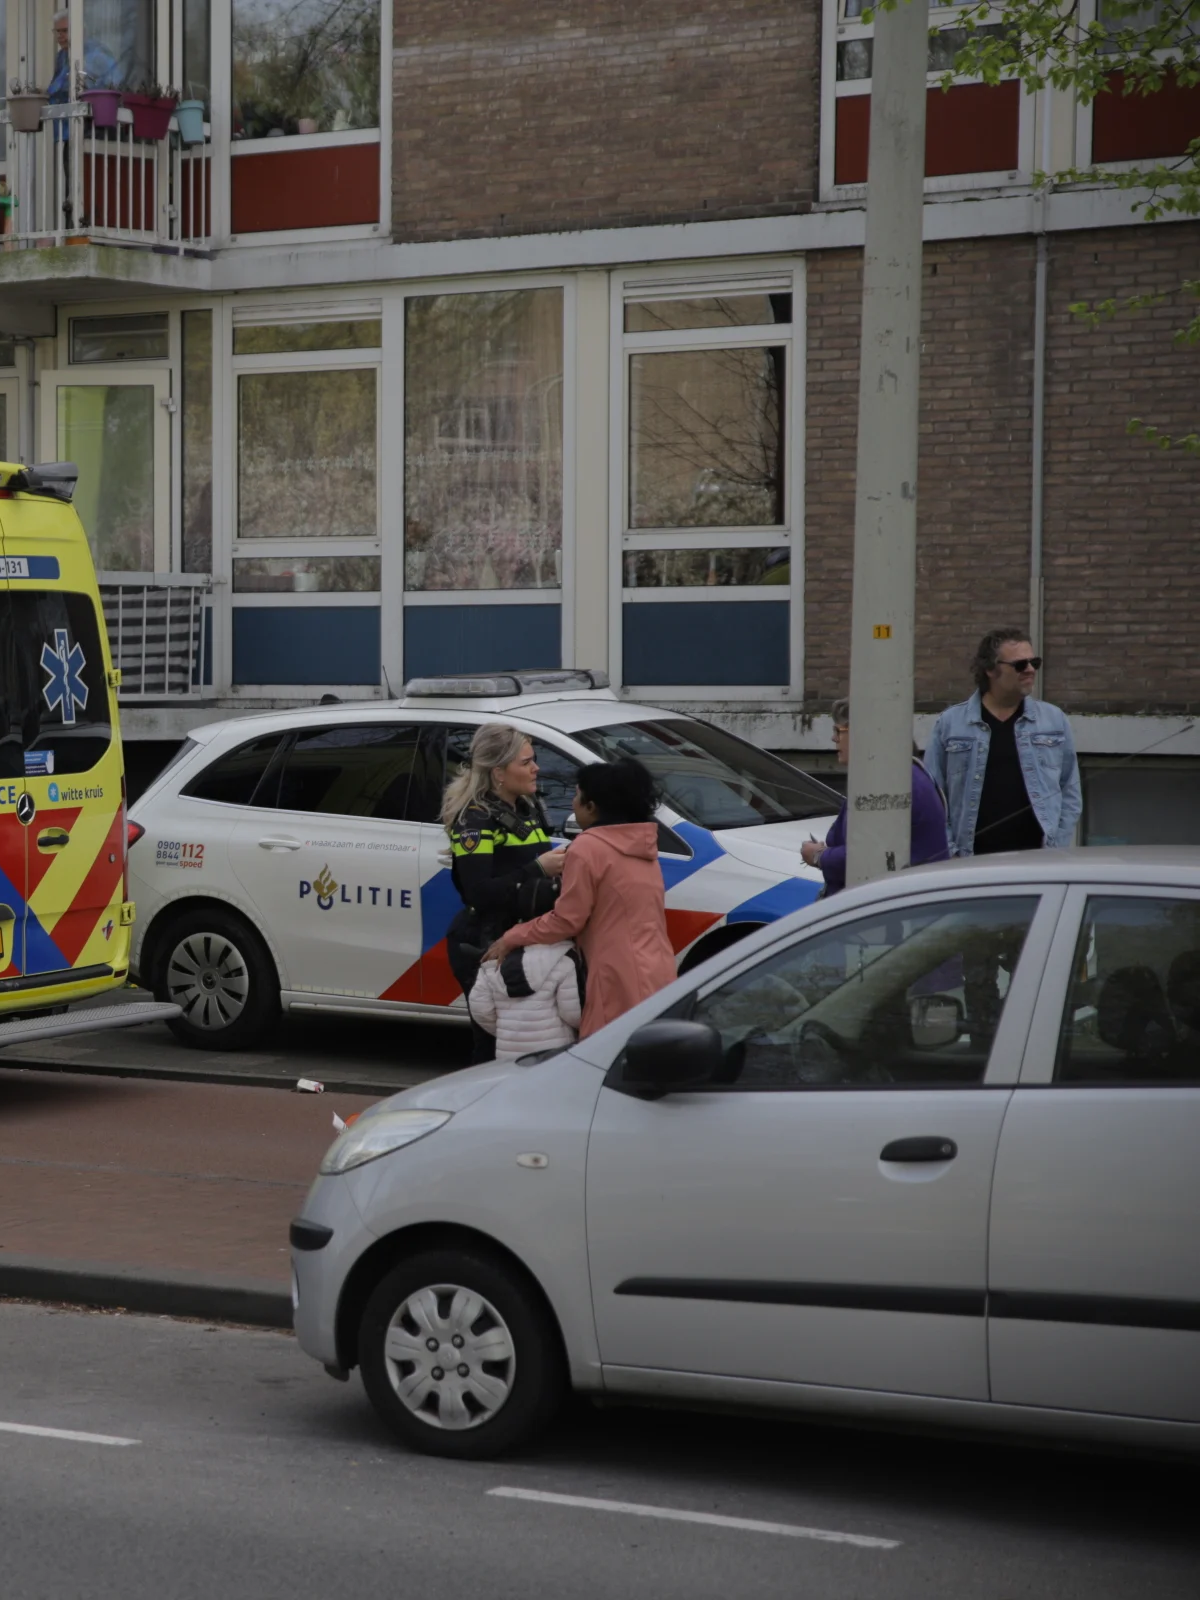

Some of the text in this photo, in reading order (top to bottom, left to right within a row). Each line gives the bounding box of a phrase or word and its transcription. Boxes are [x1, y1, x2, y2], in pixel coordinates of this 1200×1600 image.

[60, 784, 104, 802] witte kruis
[157, 840, 180, 850] 0900
[181, 843, 205, 859] 112
[156, 850, 179, 860] 8844
[179, 860, 203, 869] spoed
[299, 880, 412, 911] POLITIE
